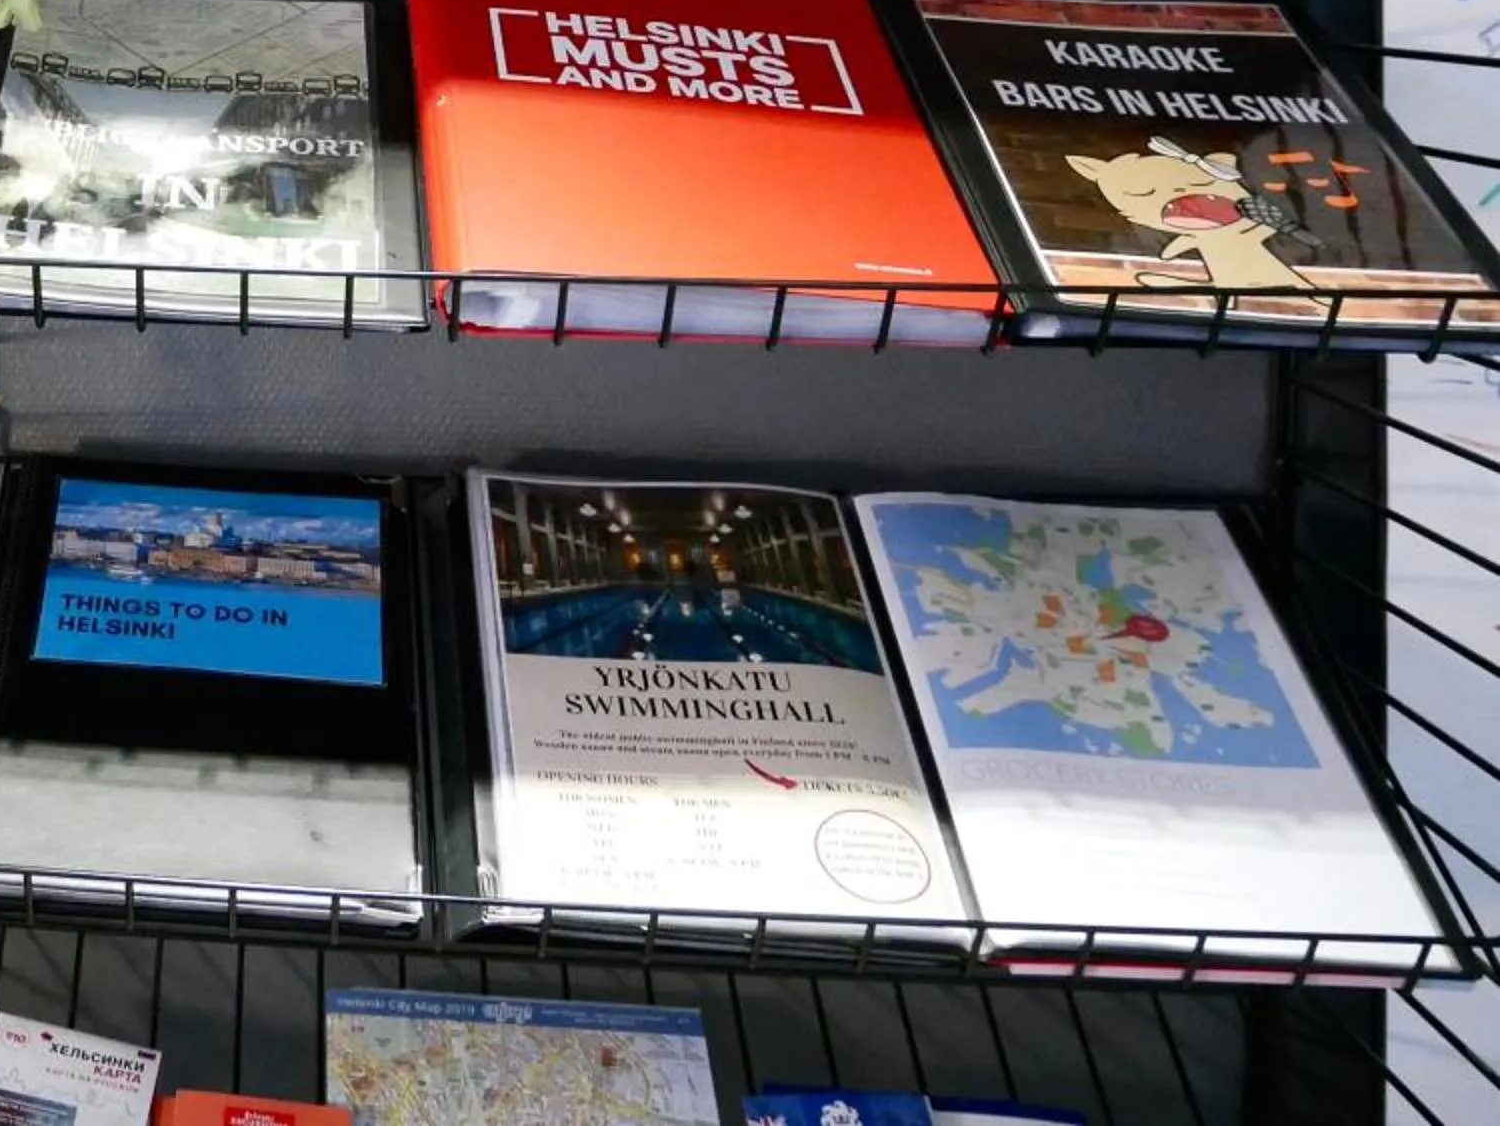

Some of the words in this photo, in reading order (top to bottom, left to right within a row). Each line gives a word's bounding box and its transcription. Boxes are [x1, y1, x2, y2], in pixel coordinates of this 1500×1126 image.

[545, 12, 786, 57] HELSINKI
[550, 36, 795, 88] MUSTS
[1044, 39, 1233, 73] KARAOKE
[557, 66, 657, 93] AND
[668, 79, 804, 109] MORE
[993, 79, 1104, 114] BARS
[1106, 87, 1155, 118] IN
[1155, 90, 1349, 124] HELSINKI
[135, 170, 221, 212] IN
[61, 592, 161, 618] THINGS
[169, 601, 206, 620] TO
[214, 605, 254, 624] DO
[262, 609, 288, 626] IN
[57, 615, 175, 640] HELSINKI
[592, 664, 792, 693] YRJÖNKATU
[565, 693, 845, 726] SWIMMINGHALL
[387, 998, 412, 1013] City
[414, 1000, 440, 1015] Map
[49, 1042, 146, 1074] ХЕЛЬСИНКИ
[93, 1064, 142, 1085] КАРТА
